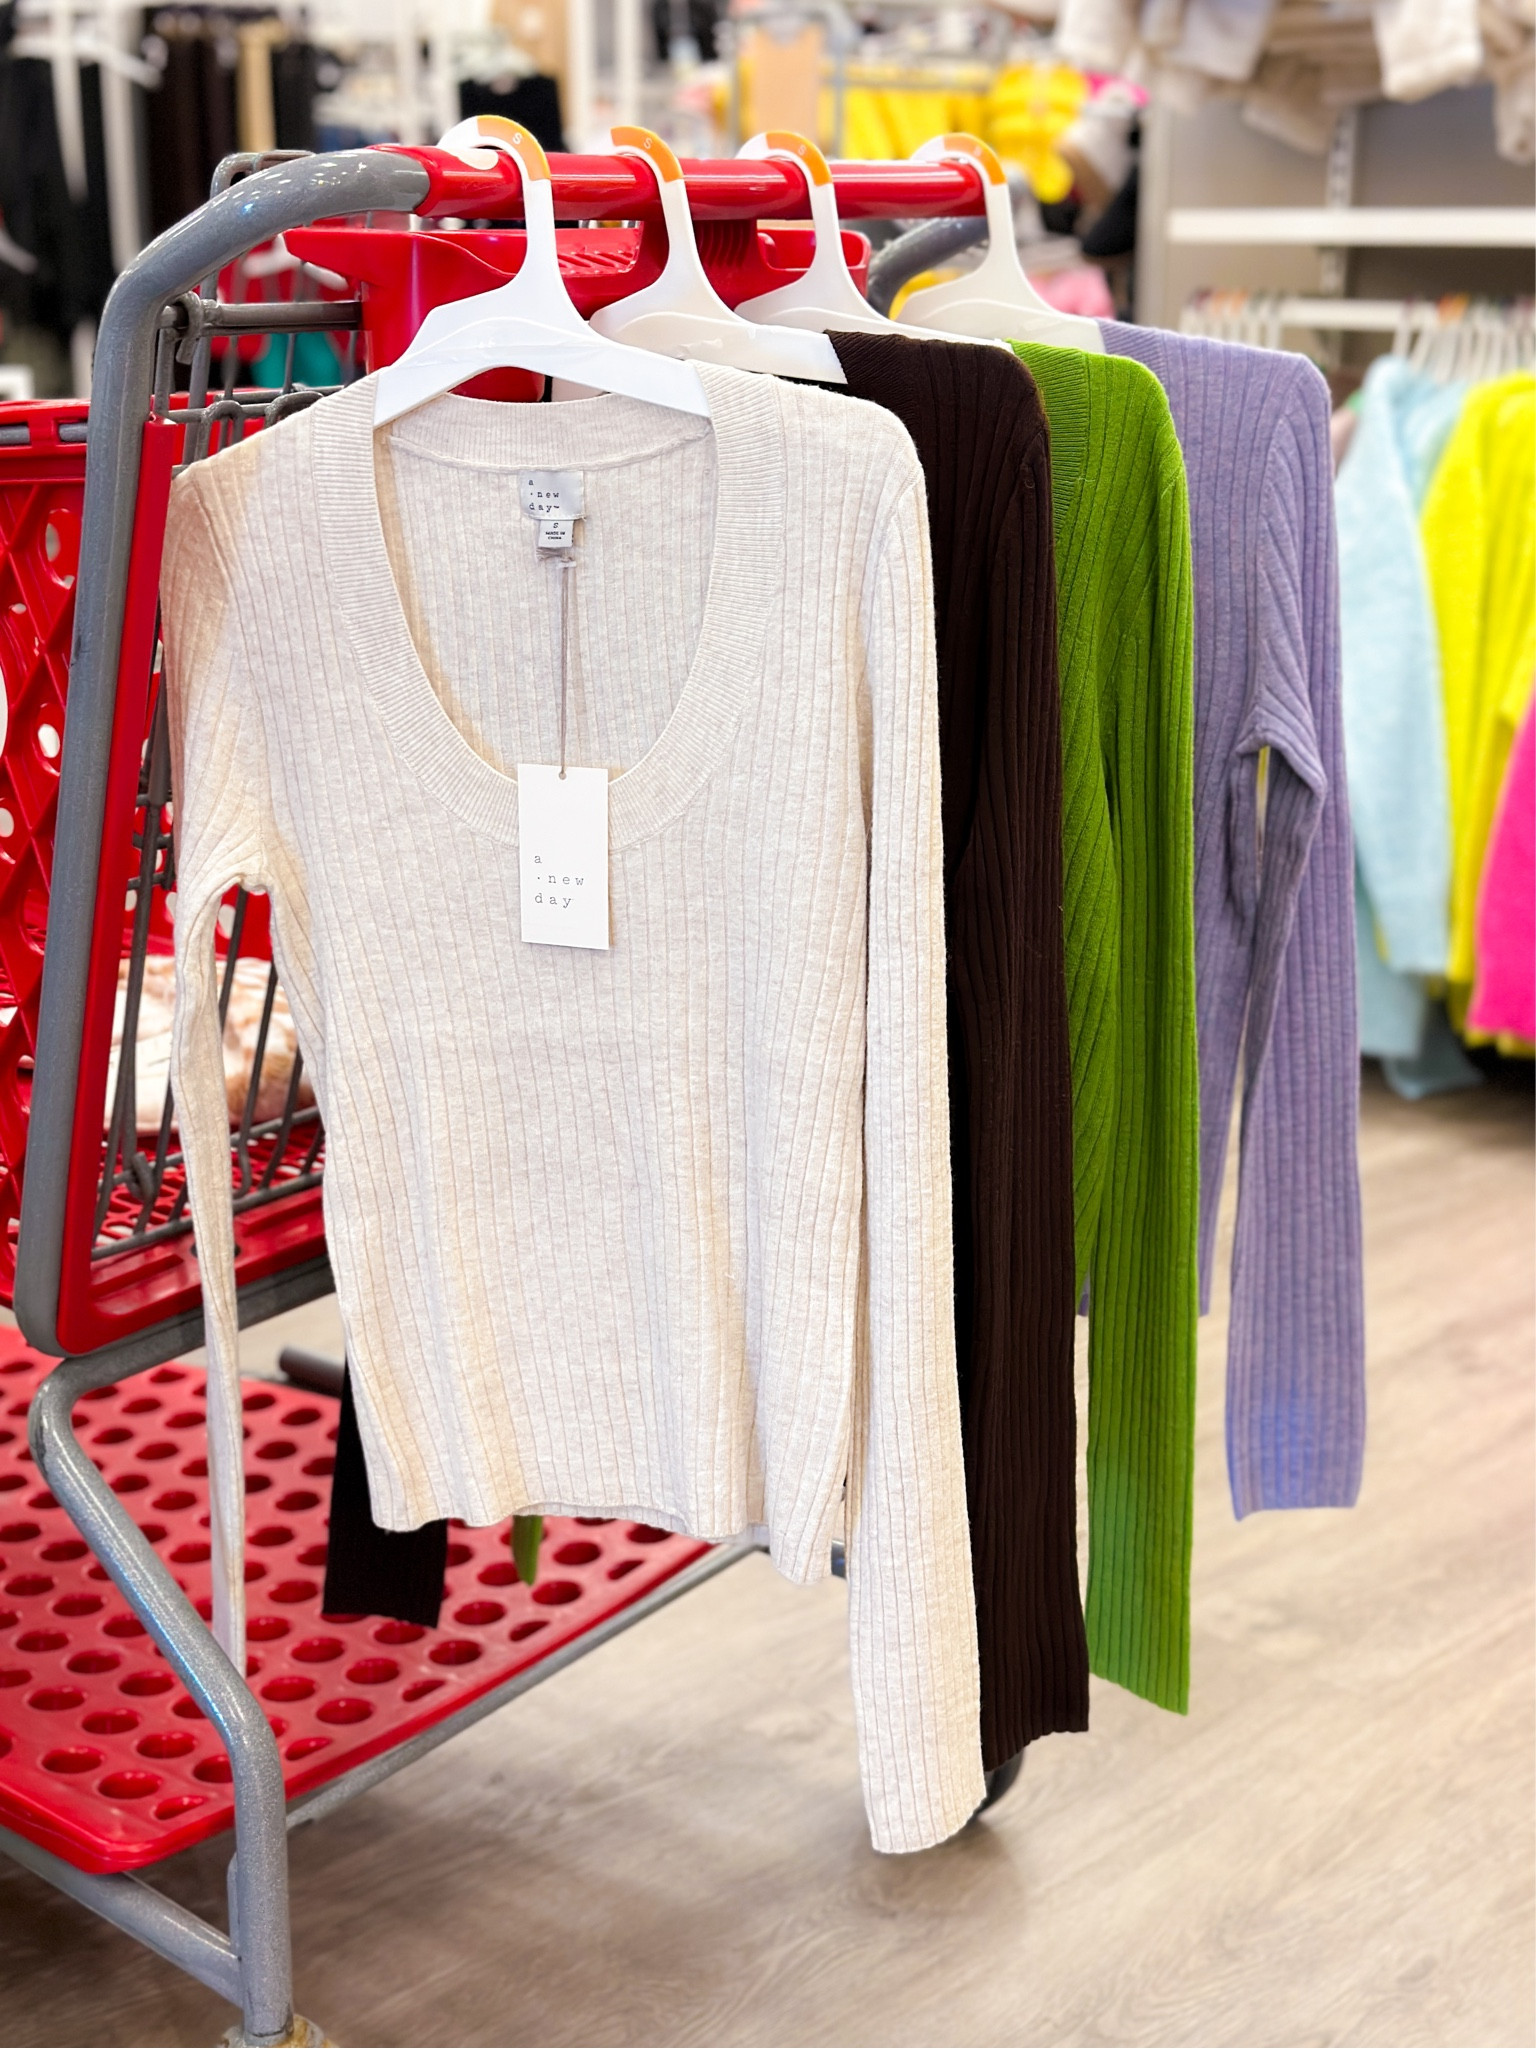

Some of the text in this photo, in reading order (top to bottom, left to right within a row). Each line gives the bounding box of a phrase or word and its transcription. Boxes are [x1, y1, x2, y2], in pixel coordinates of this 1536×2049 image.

[512, 132, 523, 145] S
[643, 137, 653, 149] S
[533, 854, 542, 864] a
[534, 892, 572, 909] day
